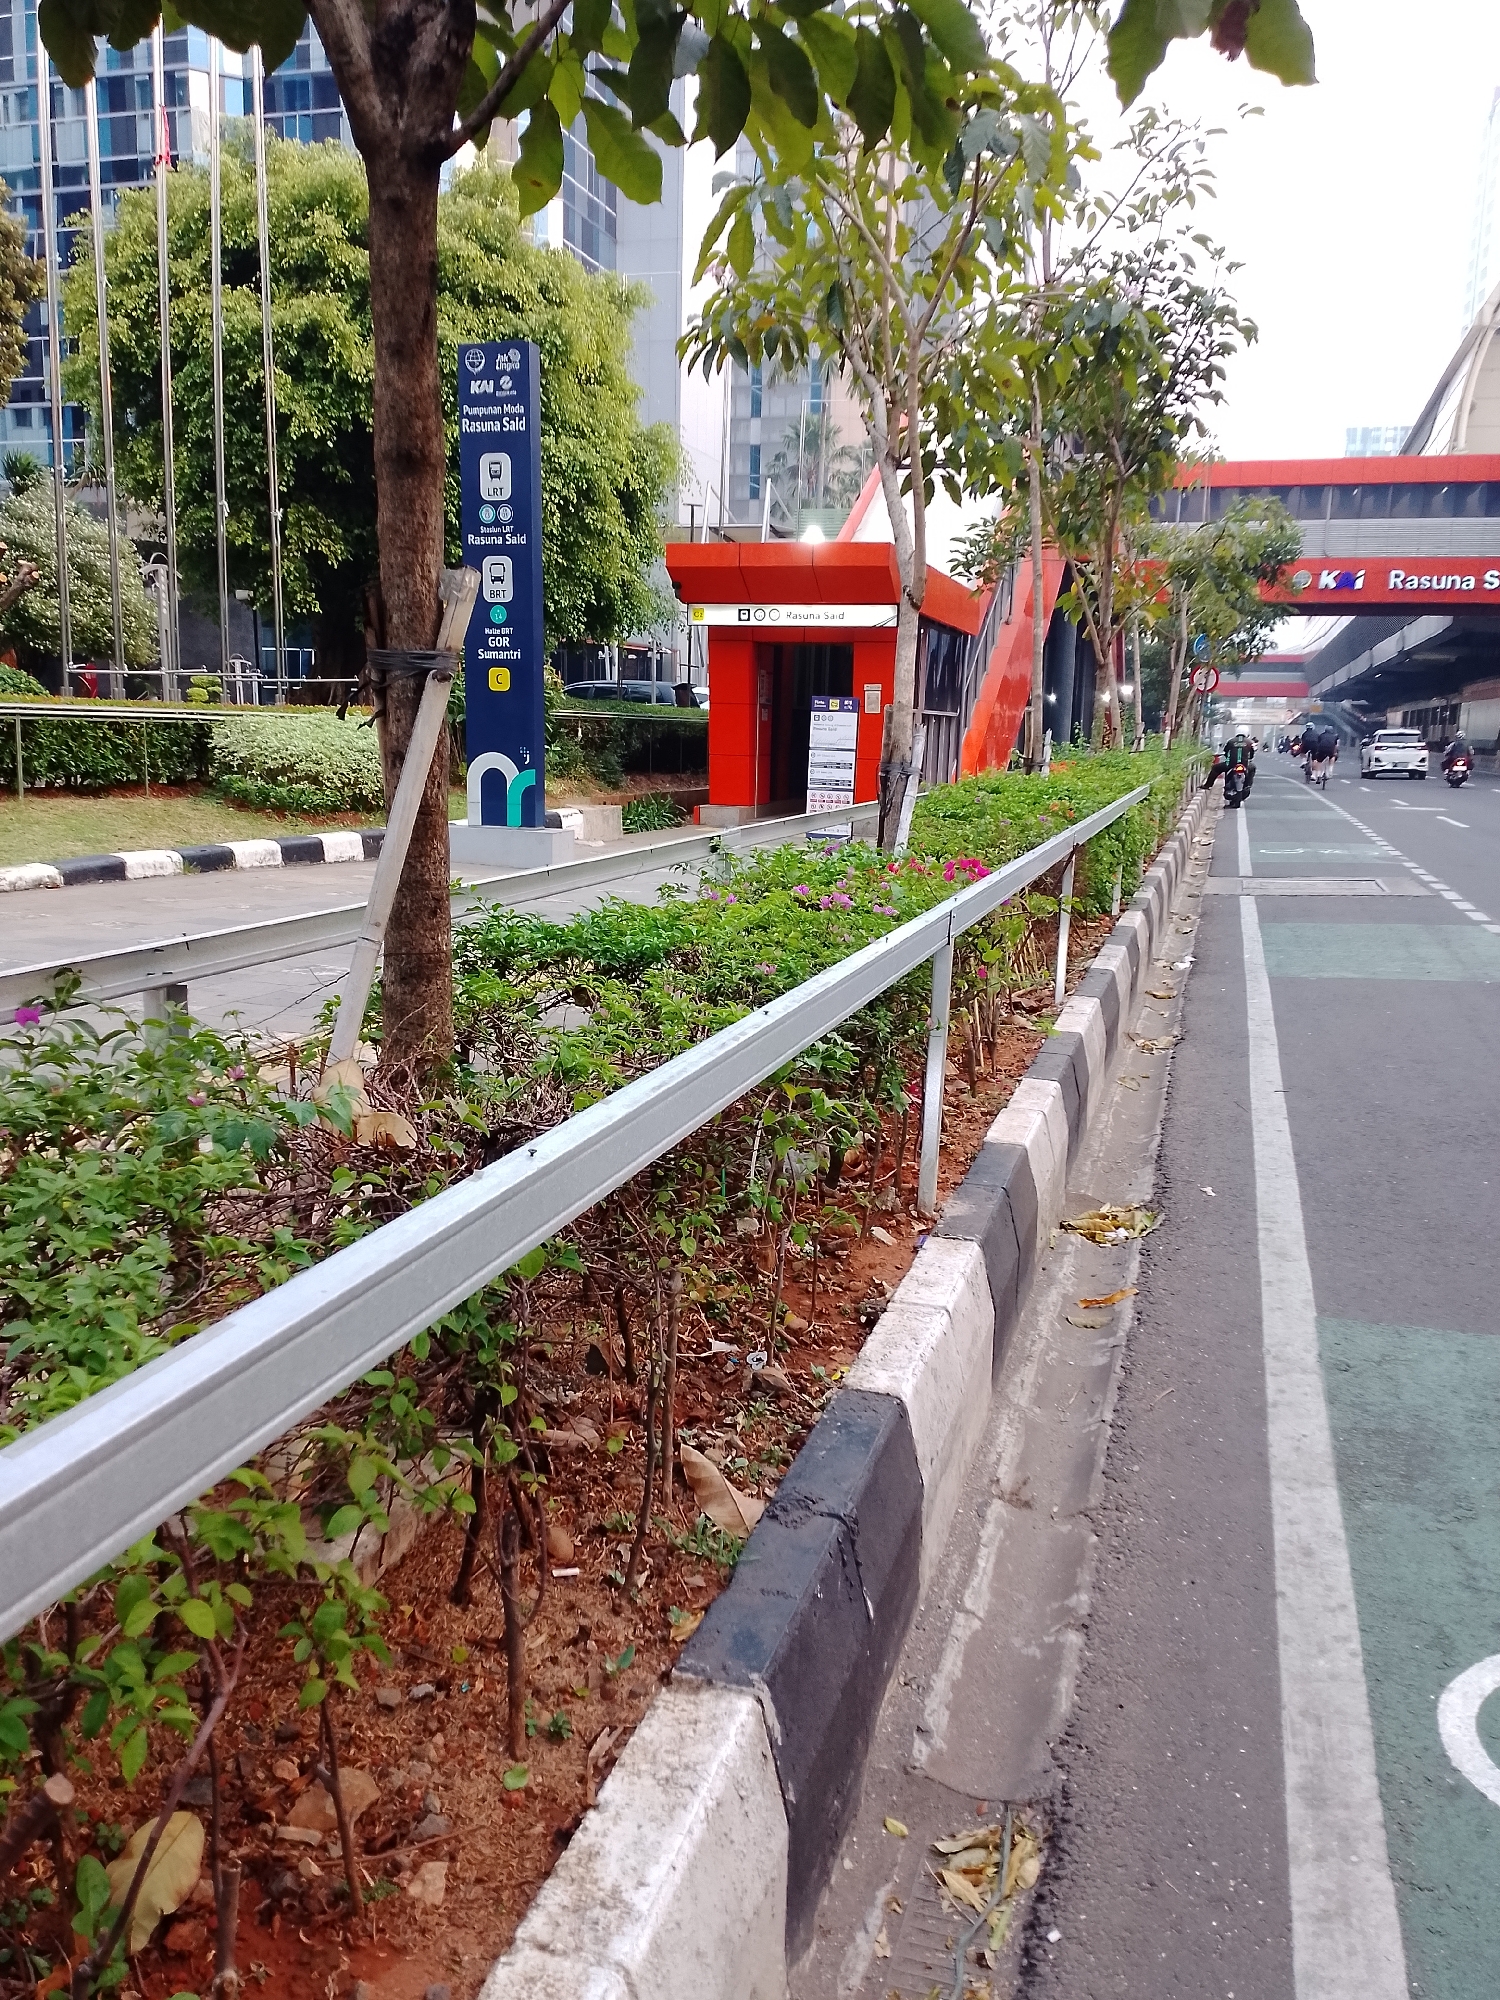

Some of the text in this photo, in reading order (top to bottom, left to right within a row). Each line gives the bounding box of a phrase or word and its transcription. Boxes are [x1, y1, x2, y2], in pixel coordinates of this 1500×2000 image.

[470, 380, 494, 394] KAI
[463, 403, 525, 417] Pumpunan Moda
[462, 416, 526, 433] Rasuna Said
[487, 487, 504, 497] LRT
[502, 525, 514, 533] LRT
[467, 533, 527, 545] Rasuna Said
[1388, 569, 1476, 591] Rasuna
[489, 589, 507, 599] BRT
[786, 611, 821, 620] Rasuna
[824, 611, 845, 620] Said
[488, 636, 510, 648] GOR
[477, 648, 521, 660] Sumantri
[495, 673, 503, 685] C
